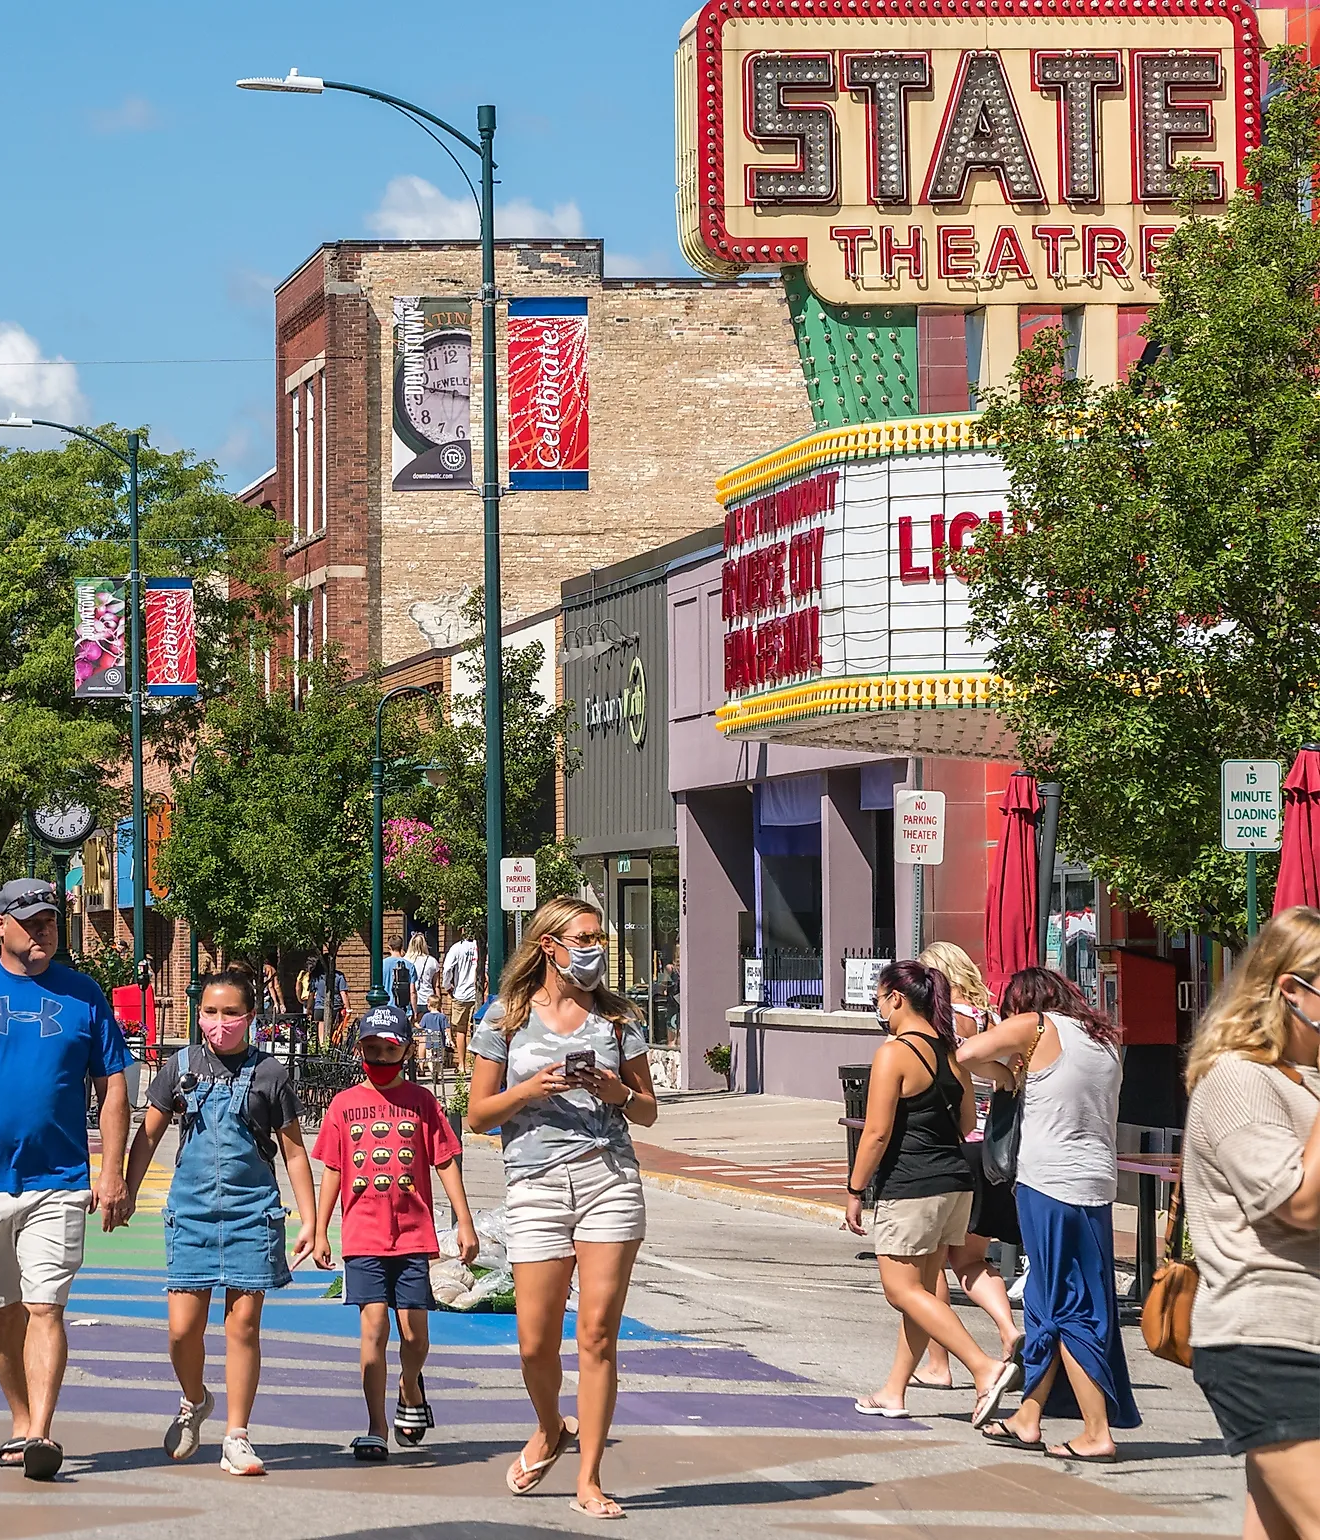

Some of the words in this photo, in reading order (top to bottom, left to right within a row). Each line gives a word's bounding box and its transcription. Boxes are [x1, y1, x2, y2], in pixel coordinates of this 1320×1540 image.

[743, 49, 1226, 206] STATE
[404, 310, 425, 395] DOWNTOWN
[443, 349, 458, 365] 12
[432, 376, 472, 389] JEWELE
[536, 320, 562, 469] Celebrate!
[421, 409, 431, 425] 8
[438, 422, 446, 434] 7
[455, 424, 466, 439] 6
[446, 453, 460, 463] TC
[789, 526, 825, 598] CITY
[82, 585, 95, 639] DOWNTOWN
[161, 591, 180, 683] Celebrate!
[1246, 773, 1257, 785] 15
[1231, 791, 1272, 803] MINUTE
[915, 801, 927, 811] NO
[1227, 808, 1277, 820] LOADING
[903, 815, 938, 826] PARKING
[58, 826, 65, 835] 6
[902, 829, 938, 840] THEATER
[1237, 826, 1267, 838] ZONE
[910, 844, 928, 854] EXIT
[513, 865, 523, 873] NO
[505, 875, 531, 883] PARKING
[505, 885, 532, 893] THEATER
[512, 896, 525, 904] EXIT
[383, 1014, 399, 1024] with
[342, 1106, 376, 1124] MOODS
